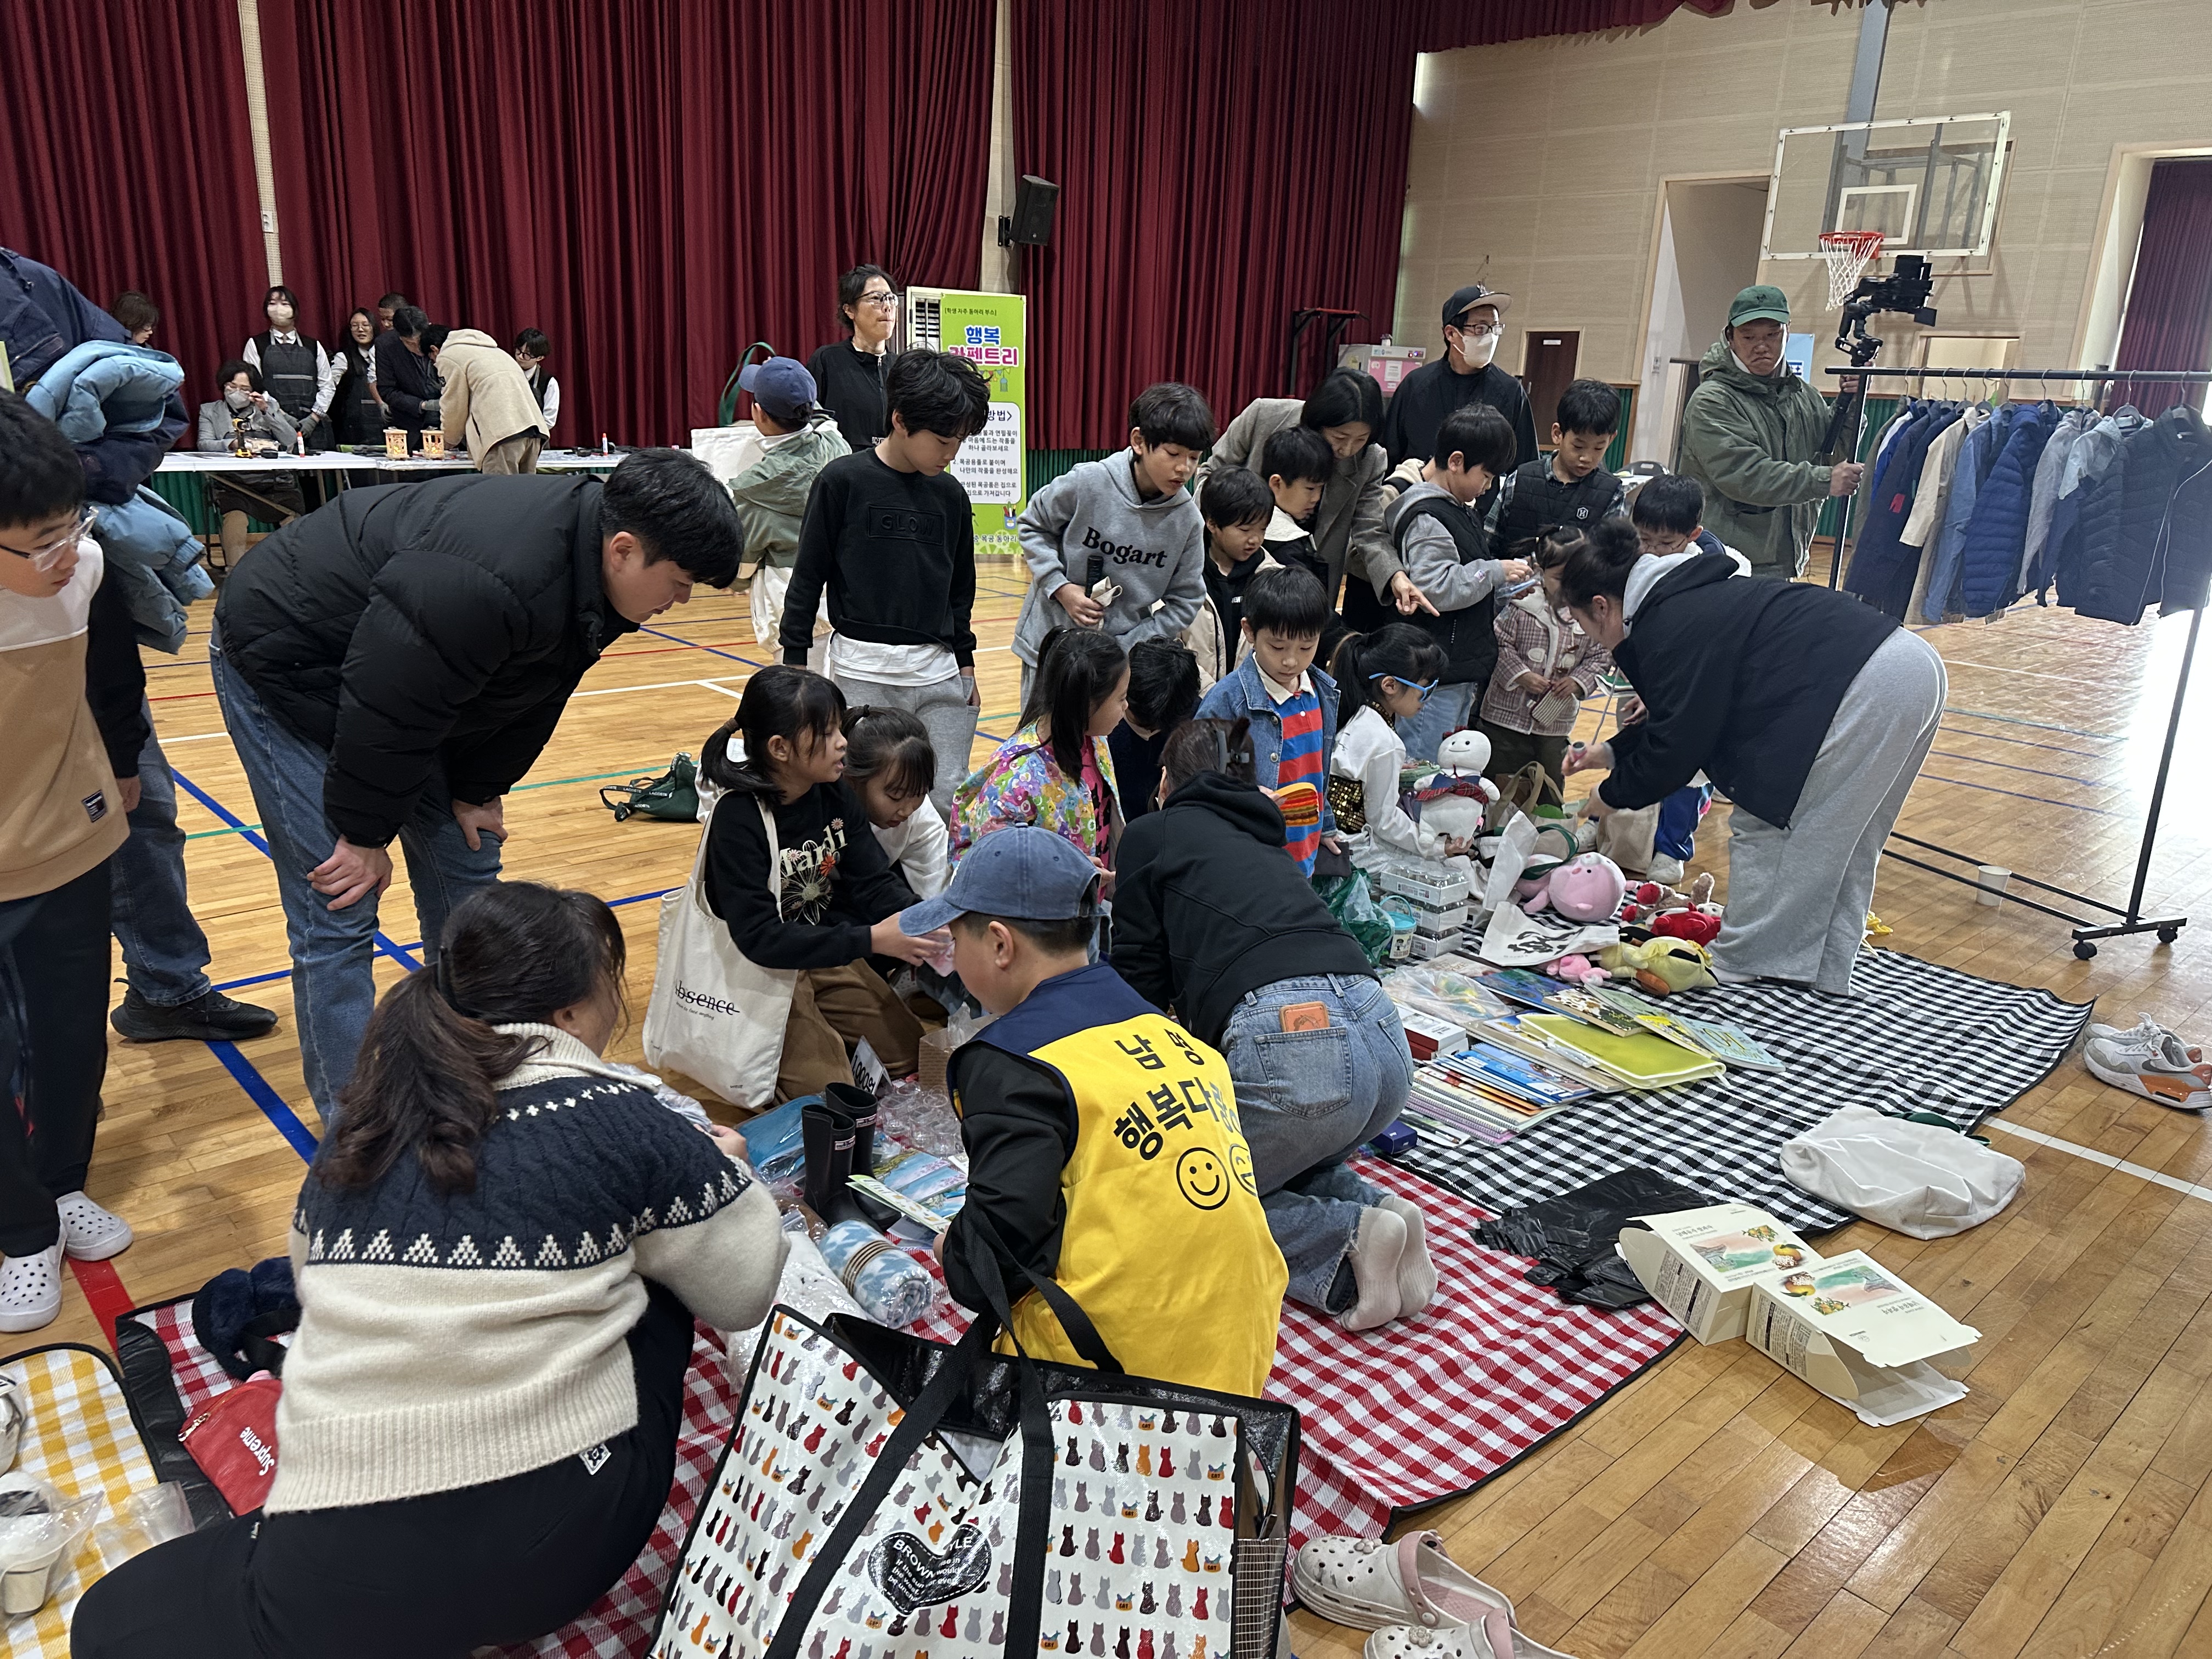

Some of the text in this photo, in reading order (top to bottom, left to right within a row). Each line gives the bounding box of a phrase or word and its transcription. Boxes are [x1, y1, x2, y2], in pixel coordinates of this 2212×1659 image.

[966, 326, 1000, 345] 행복
[881, 514, 935, 536] GLOW
[997, 535, 1017, 543] 동아리
[1082, 526, 1167, 568] Bogart
[1114, 1034, 1166, 1070] 남
[240, 1426, 275, 1476] Supreme
[893, 1539, 934, 1578] BROWN
[892, 1566, 904, 1578] the
[902, 1565, 912, 1578] the
[912, 1577, 925, 1589] sun
